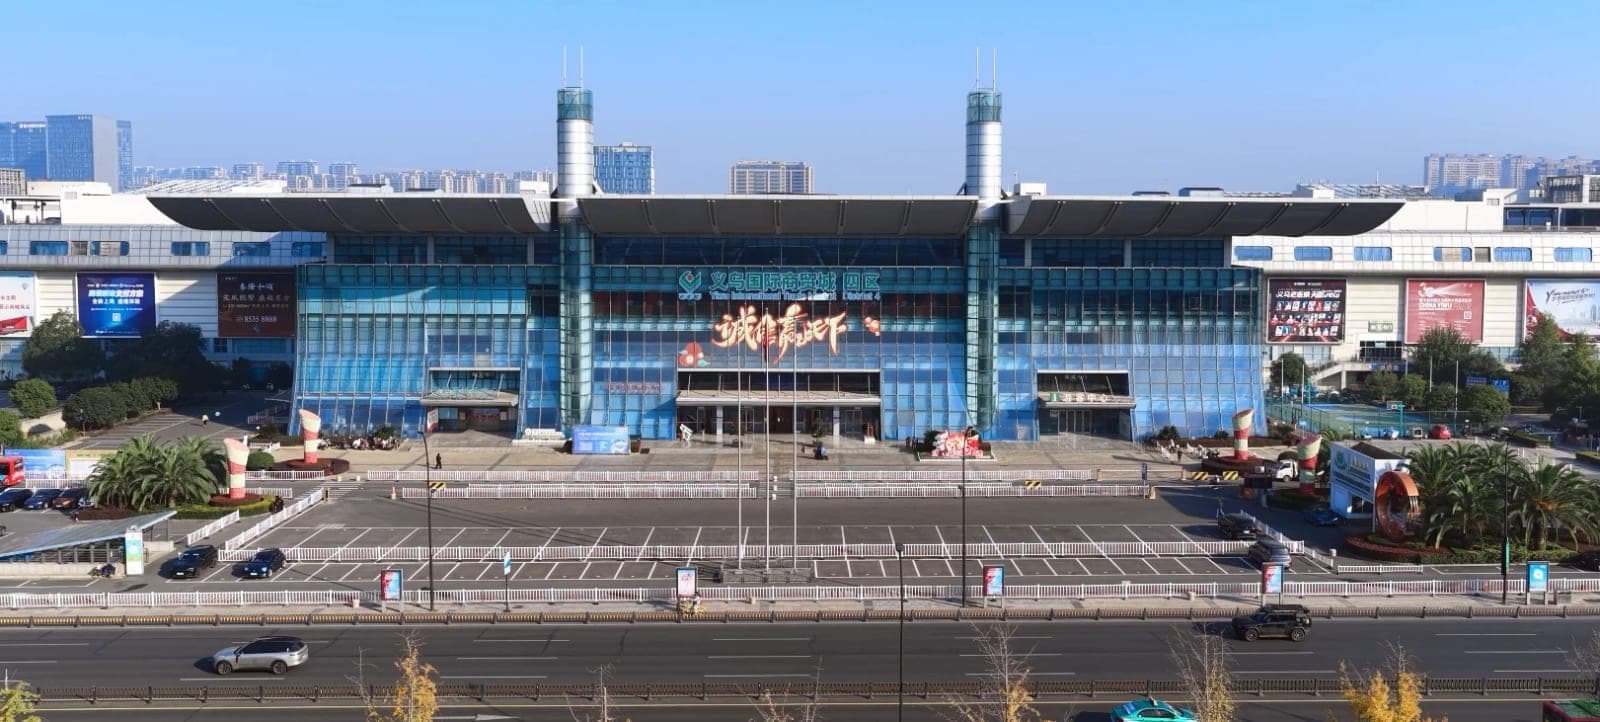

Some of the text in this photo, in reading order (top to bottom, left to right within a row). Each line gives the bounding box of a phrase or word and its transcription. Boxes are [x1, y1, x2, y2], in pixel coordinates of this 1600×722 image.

[709, 270, 881, 292] 义乌国际商贸城 四区
